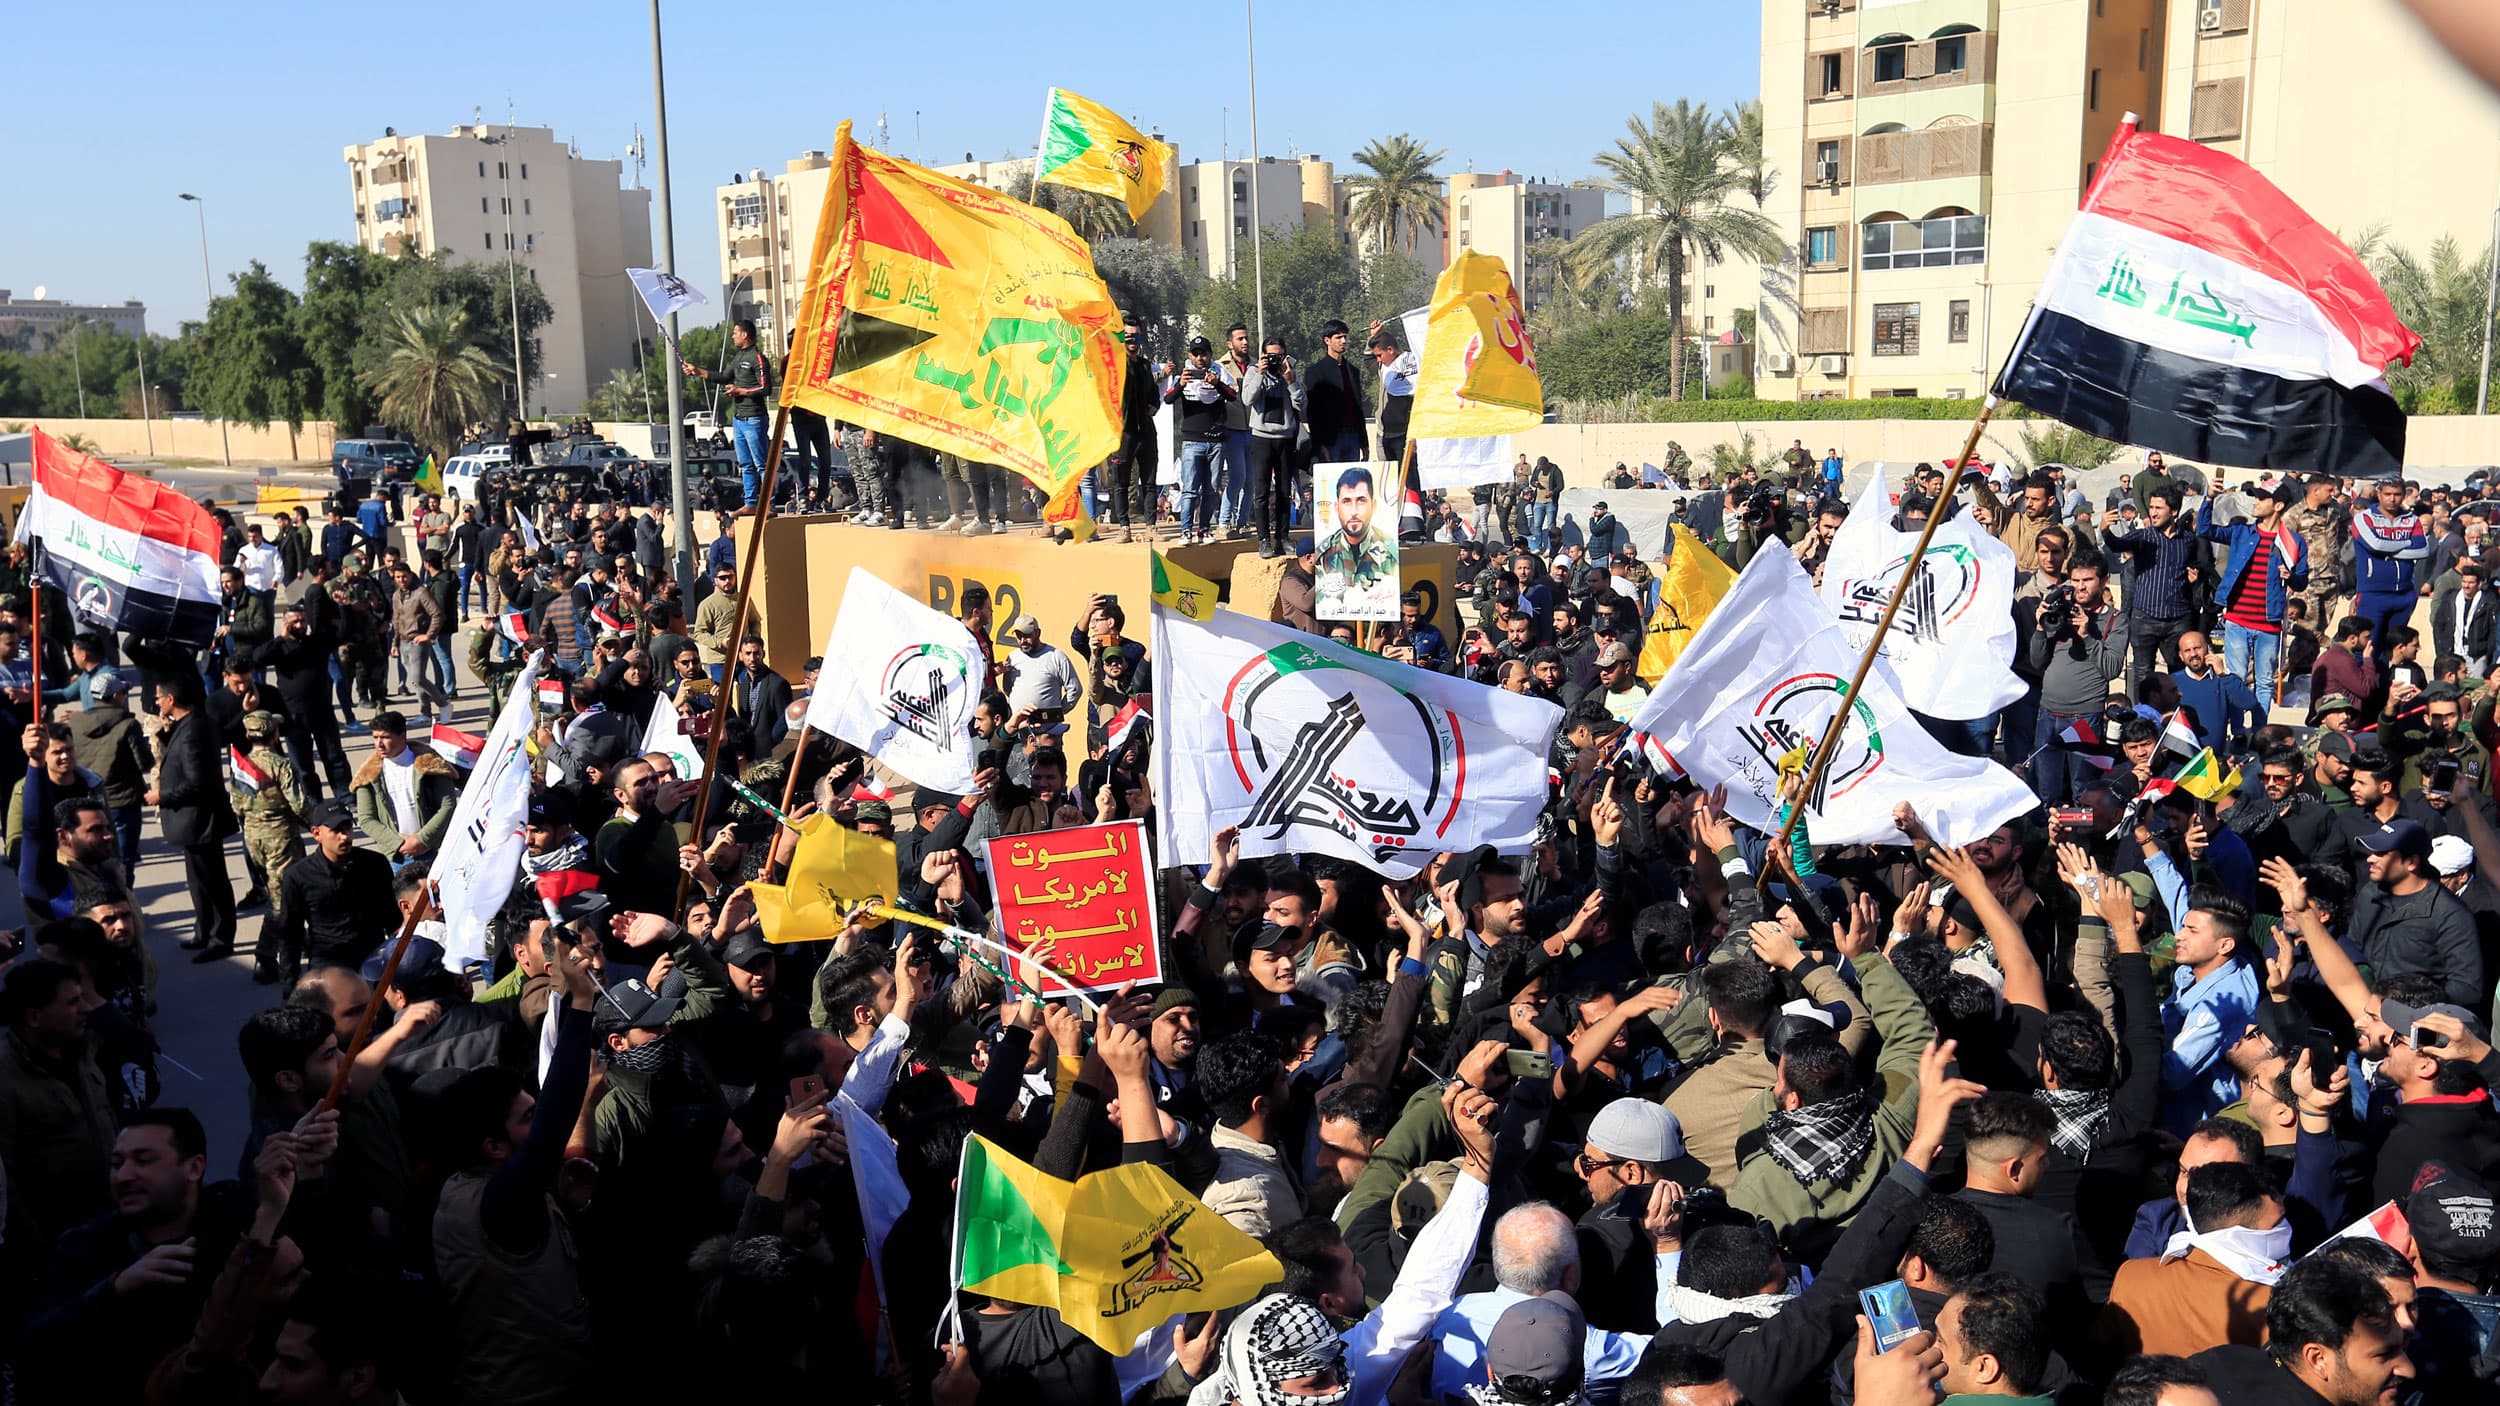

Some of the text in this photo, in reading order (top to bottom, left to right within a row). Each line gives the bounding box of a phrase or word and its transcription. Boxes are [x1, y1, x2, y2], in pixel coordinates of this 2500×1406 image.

[1010, 831, 1128, 871] الموت
[1013, 868, 1129, 910] لأمريكا
[1017, 908, 1139, 947] الموت
[2459, 1228, 2486, 1238] LEVI'S
